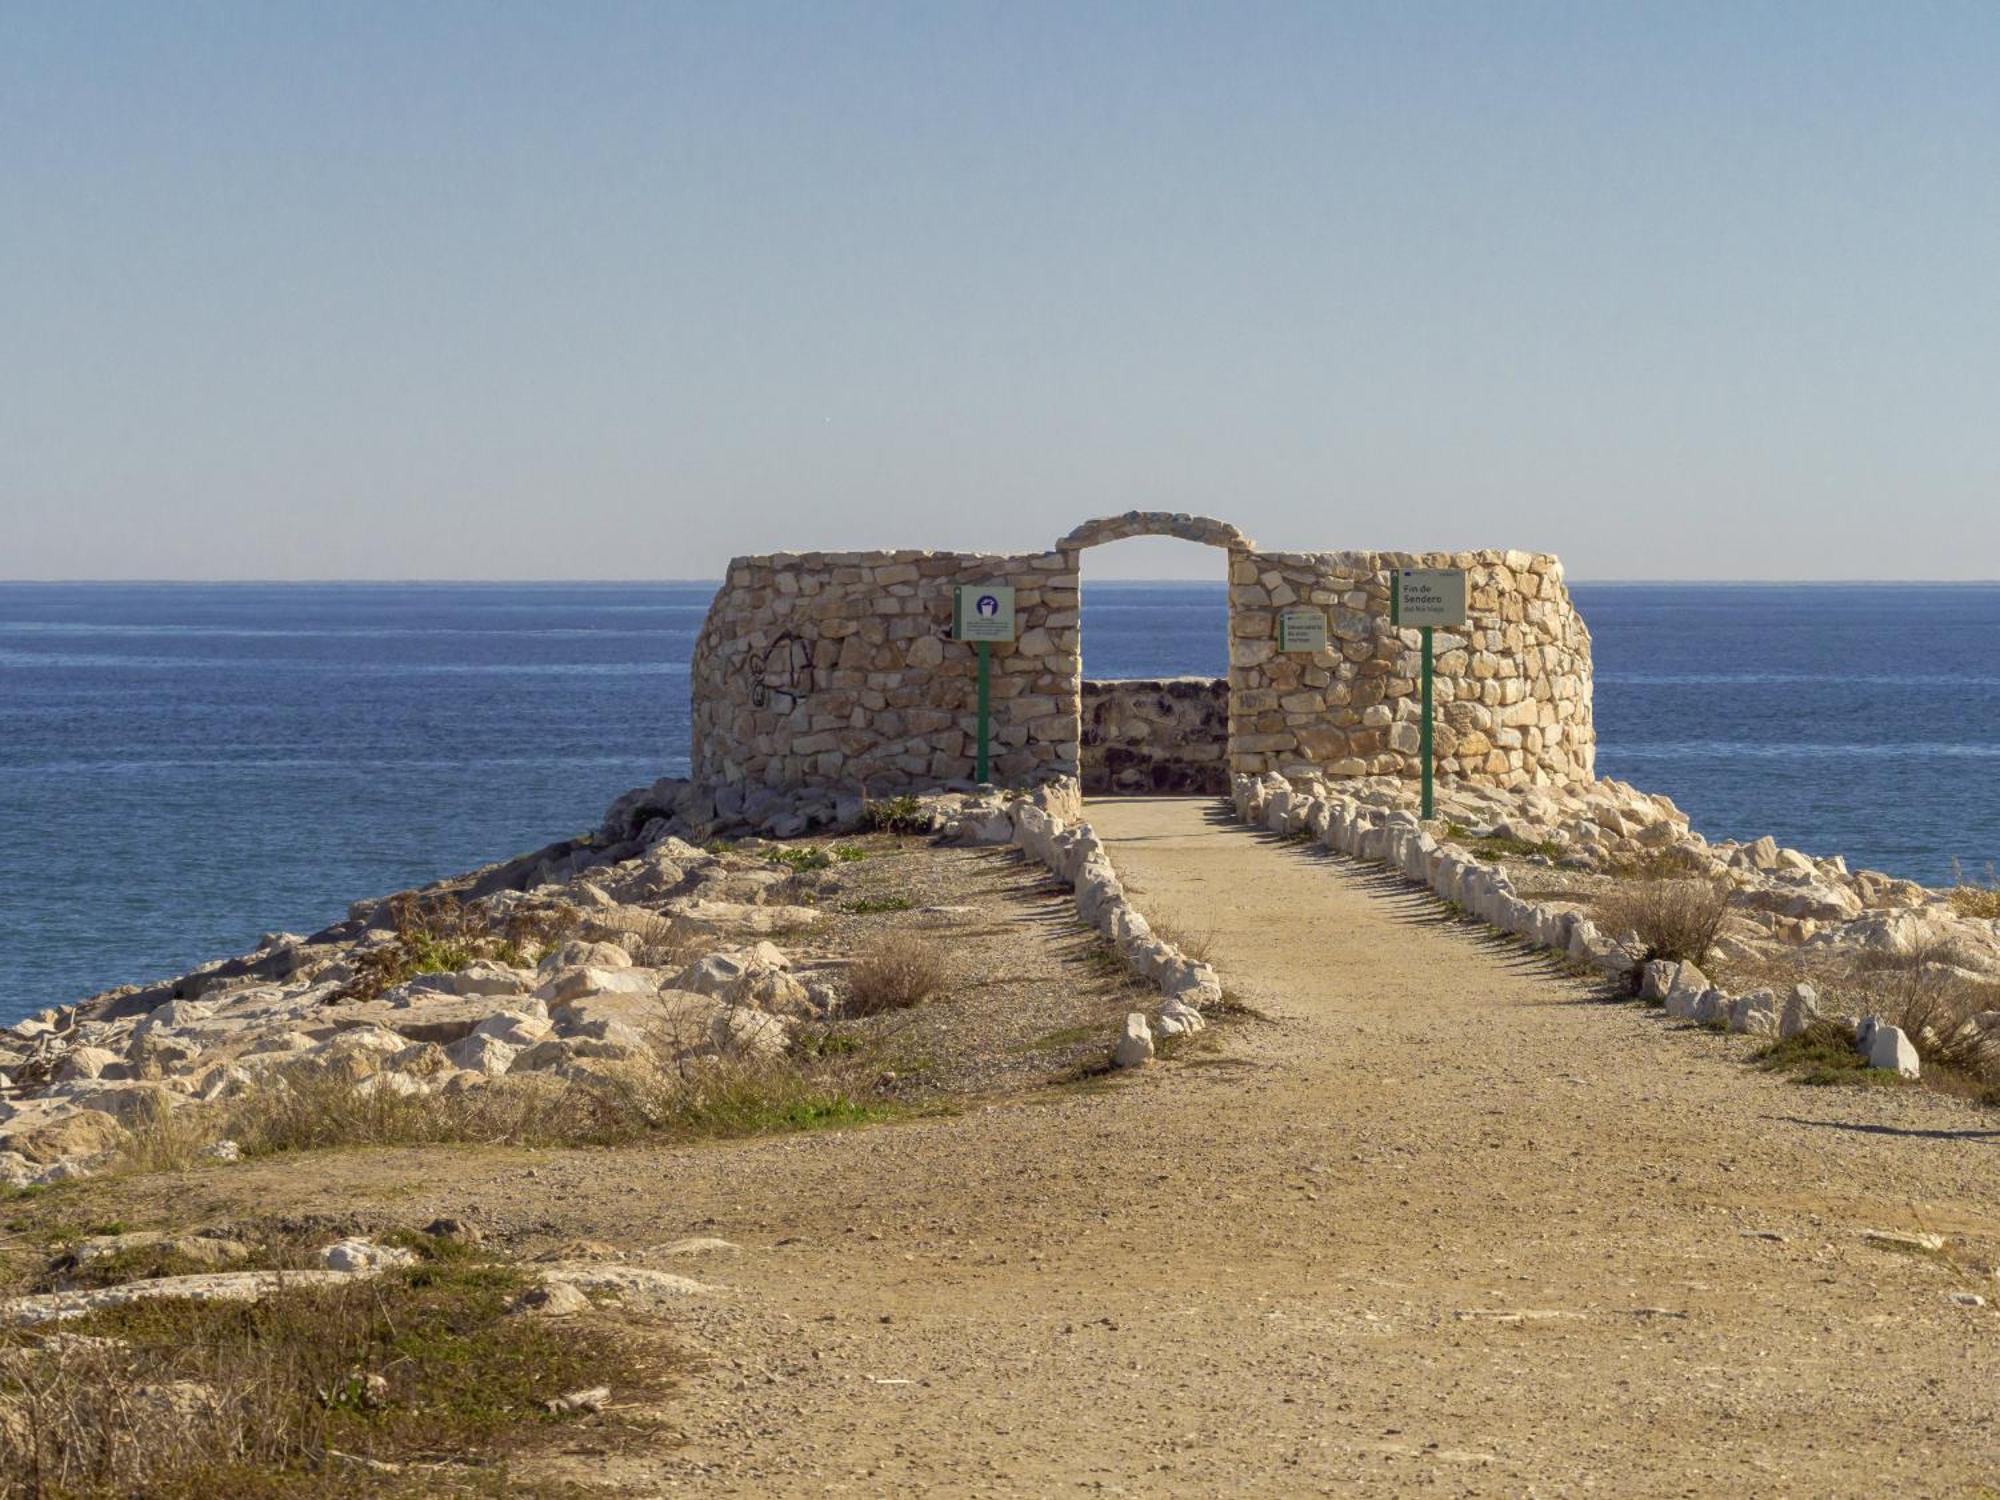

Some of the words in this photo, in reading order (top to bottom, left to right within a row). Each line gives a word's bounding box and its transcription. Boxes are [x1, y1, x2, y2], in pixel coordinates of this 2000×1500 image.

[1403, 584, 1418, 593] Fin
[1420, 584, 1432, 593] de
[1403, 594, 1442, 603] Sendero
